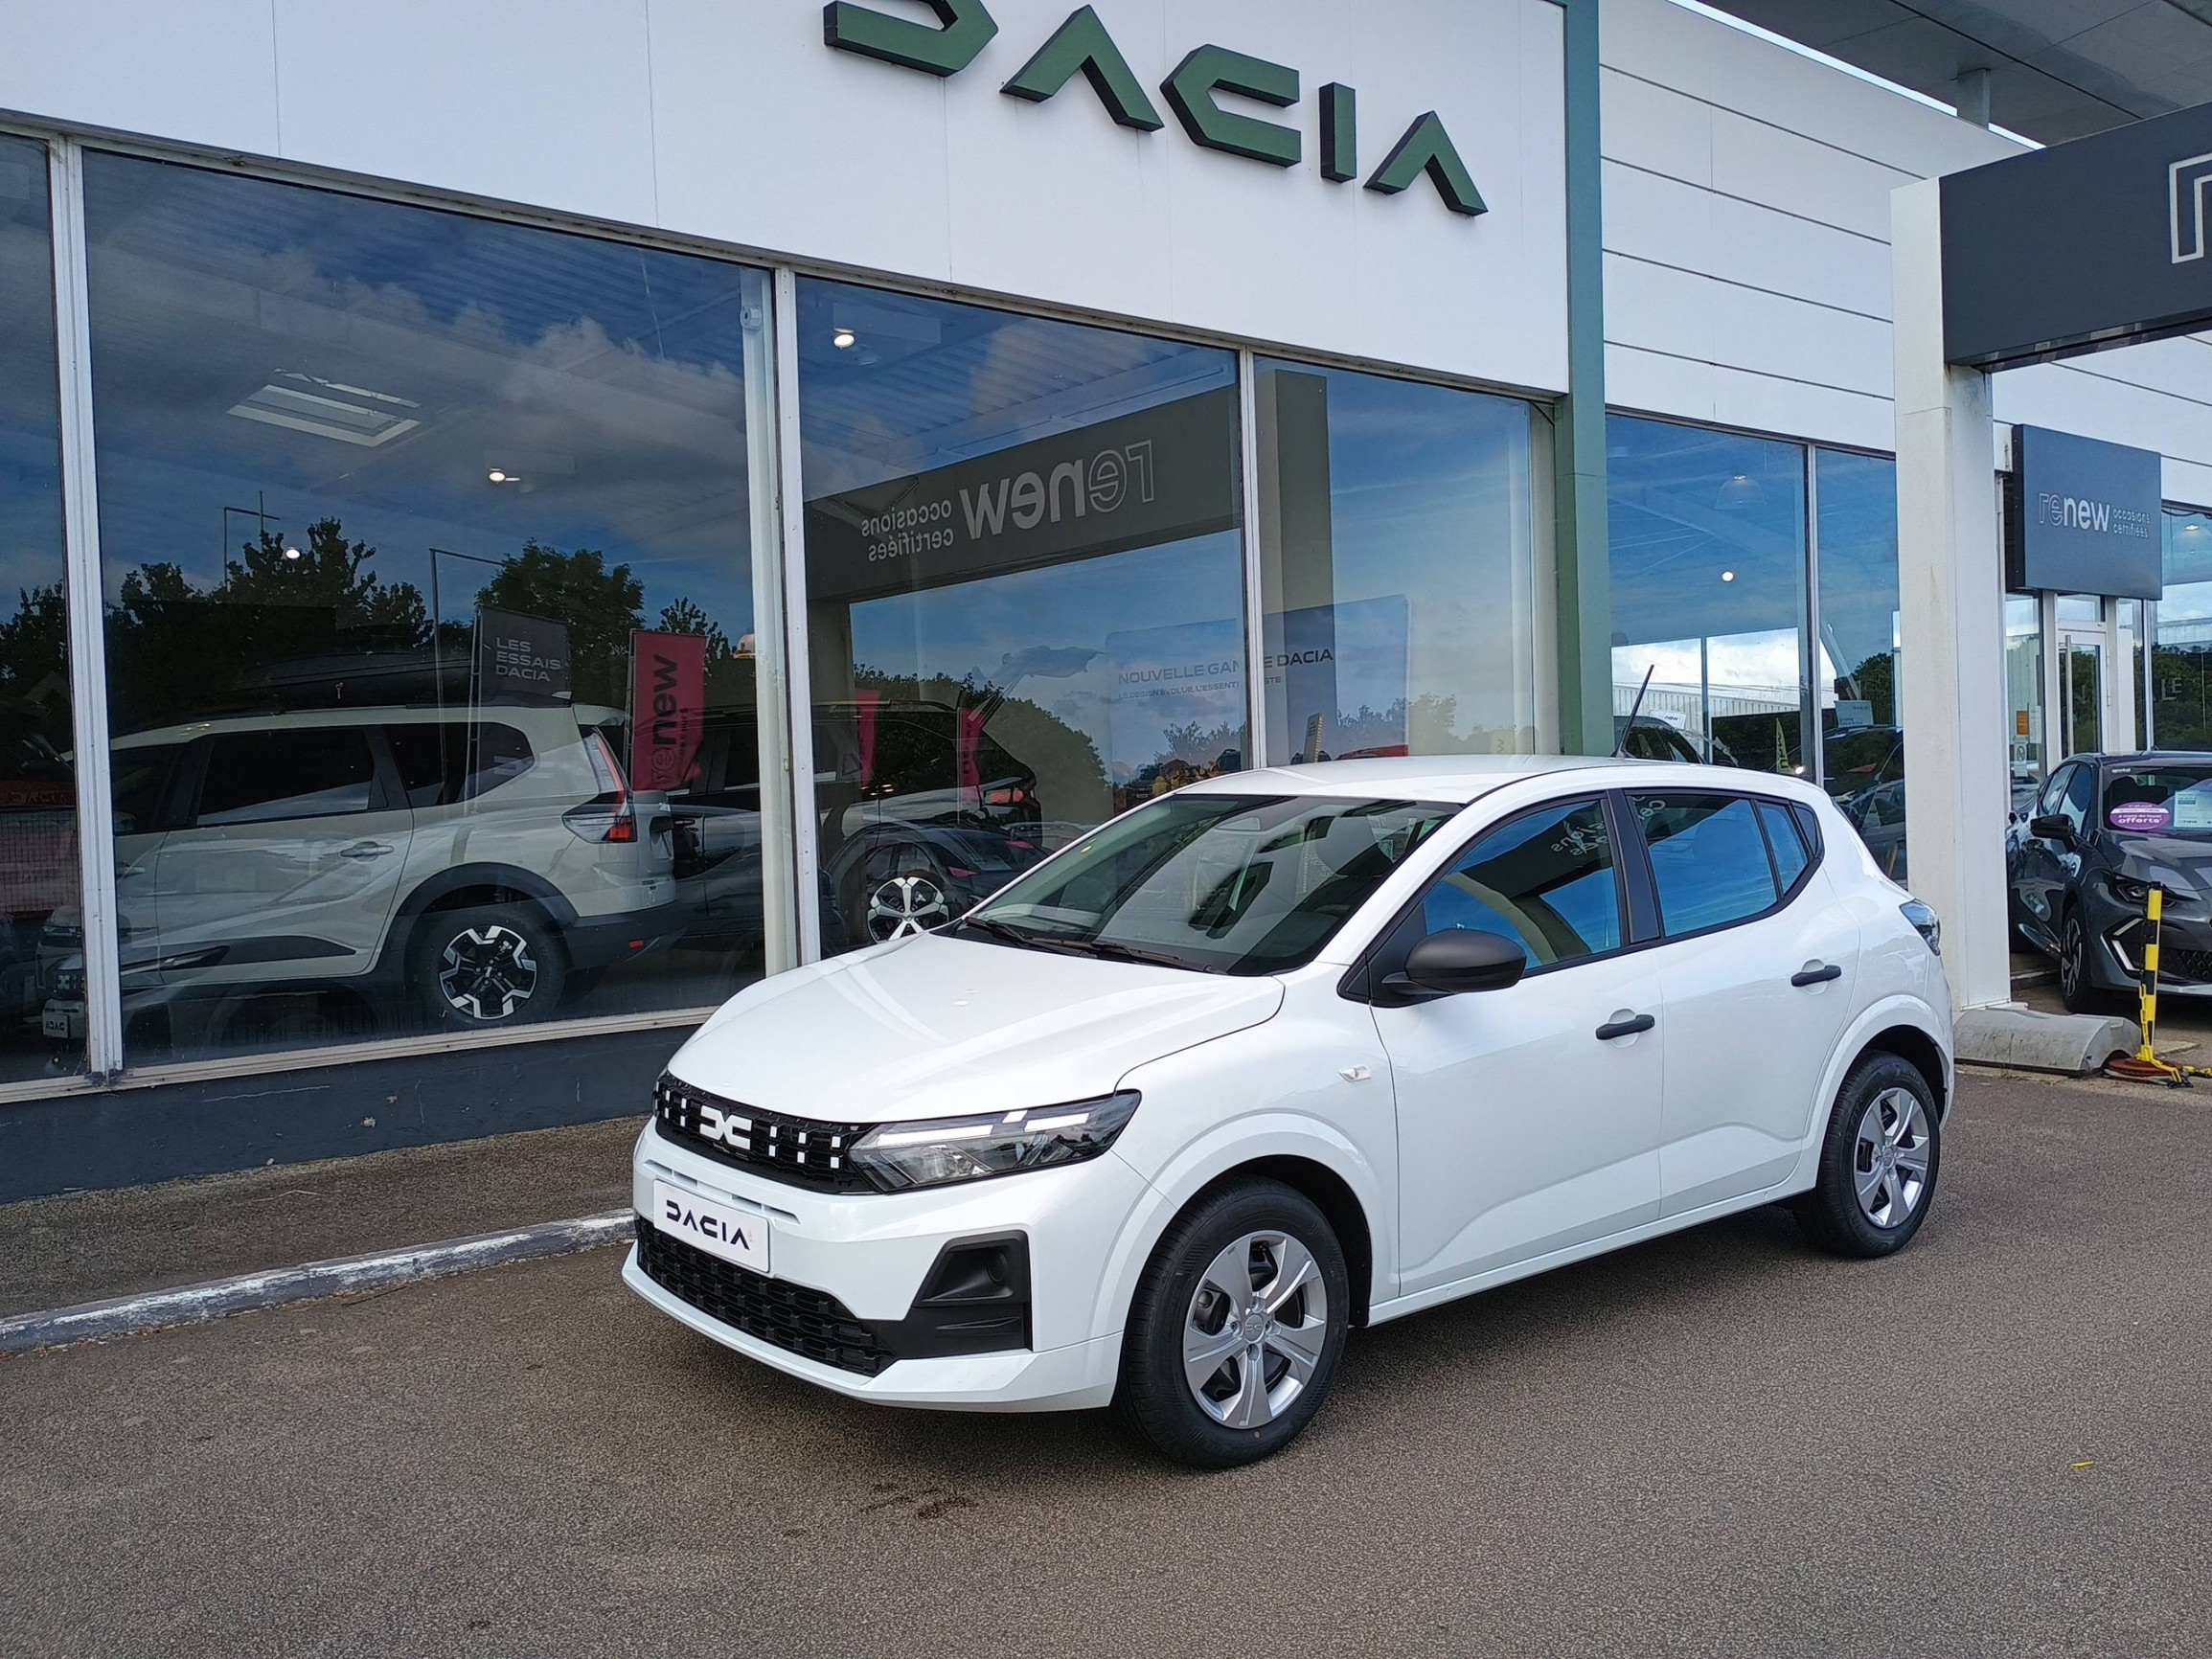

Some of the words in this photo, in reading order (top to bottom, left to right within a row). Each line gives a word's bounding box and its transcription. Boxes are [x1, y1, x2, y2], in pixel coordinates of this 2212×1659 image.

[824, 0, 1489, 216] DACIA
[2039, 492, 2110, 533] renew
[496, 637, 531, 652] LES
[496, 651, 561, 670] ESSAIS
[495, 664, 551, 682] DACIA
[1118, 664, 1204, 685] NOUVELLE
[1276, 648, 1334, 667] DACIA
[666, 1199, 751, 1251] DACIA
